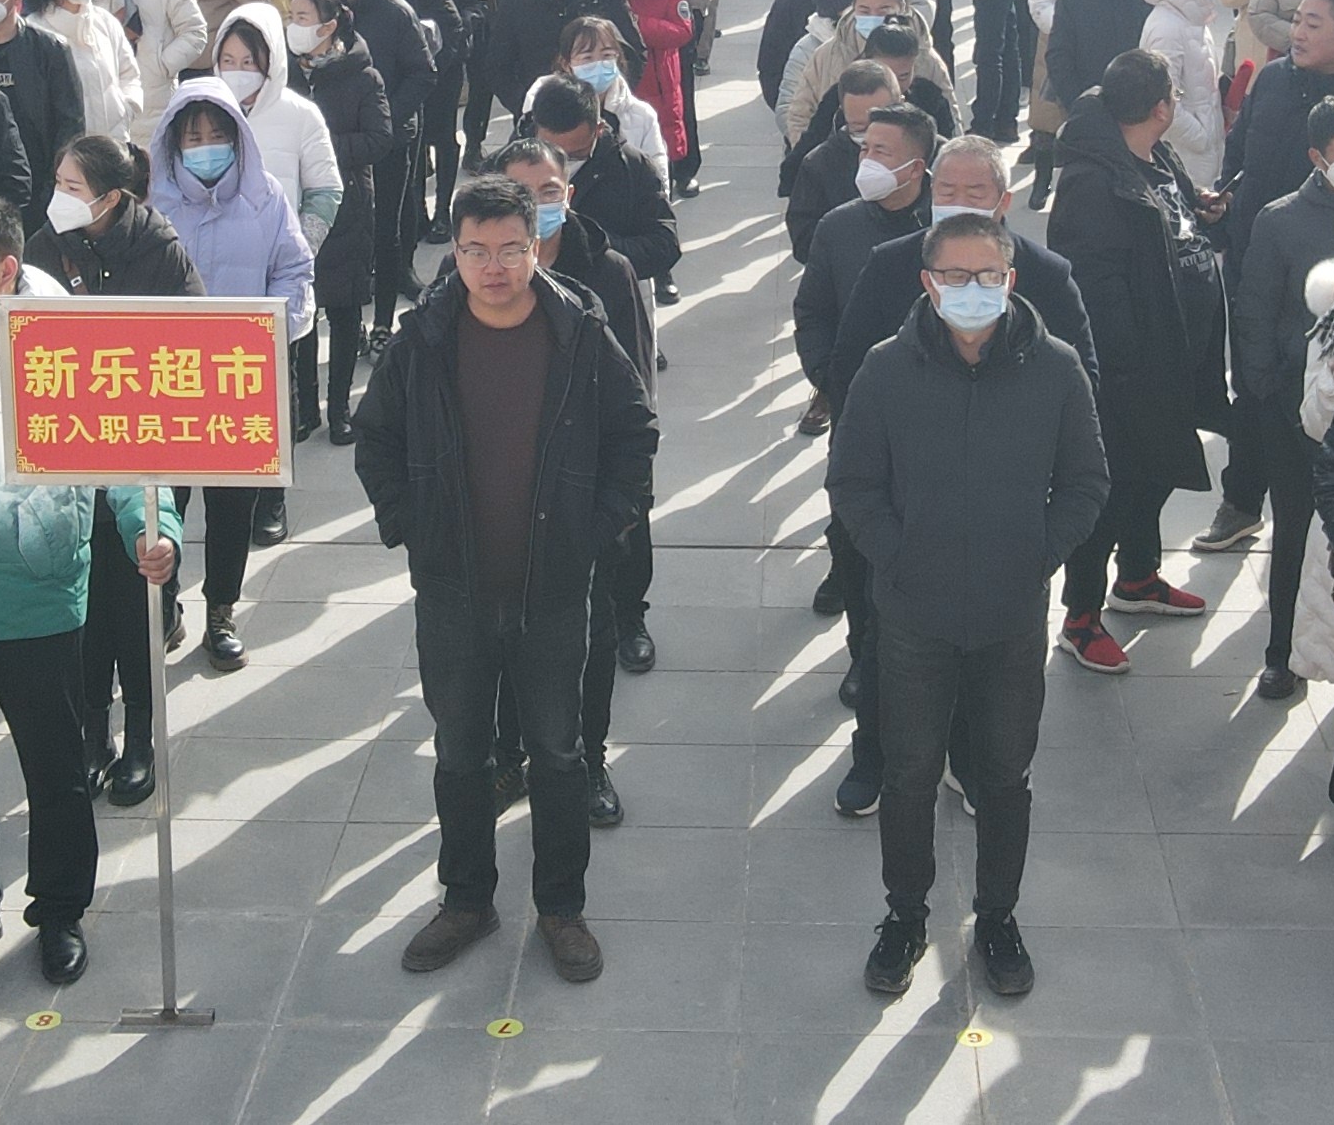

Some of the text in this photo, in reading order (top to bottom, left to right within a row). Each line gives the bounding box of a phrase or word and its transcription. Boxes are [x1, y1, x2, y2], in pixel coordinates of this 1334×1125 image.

[24, 346, 267, 400] 新乐超市
[28, 414, 274, 445] 新入职员工代表
[36, 1014, 53, 1026] 8
[498, 1022, 512, 1034] 7
